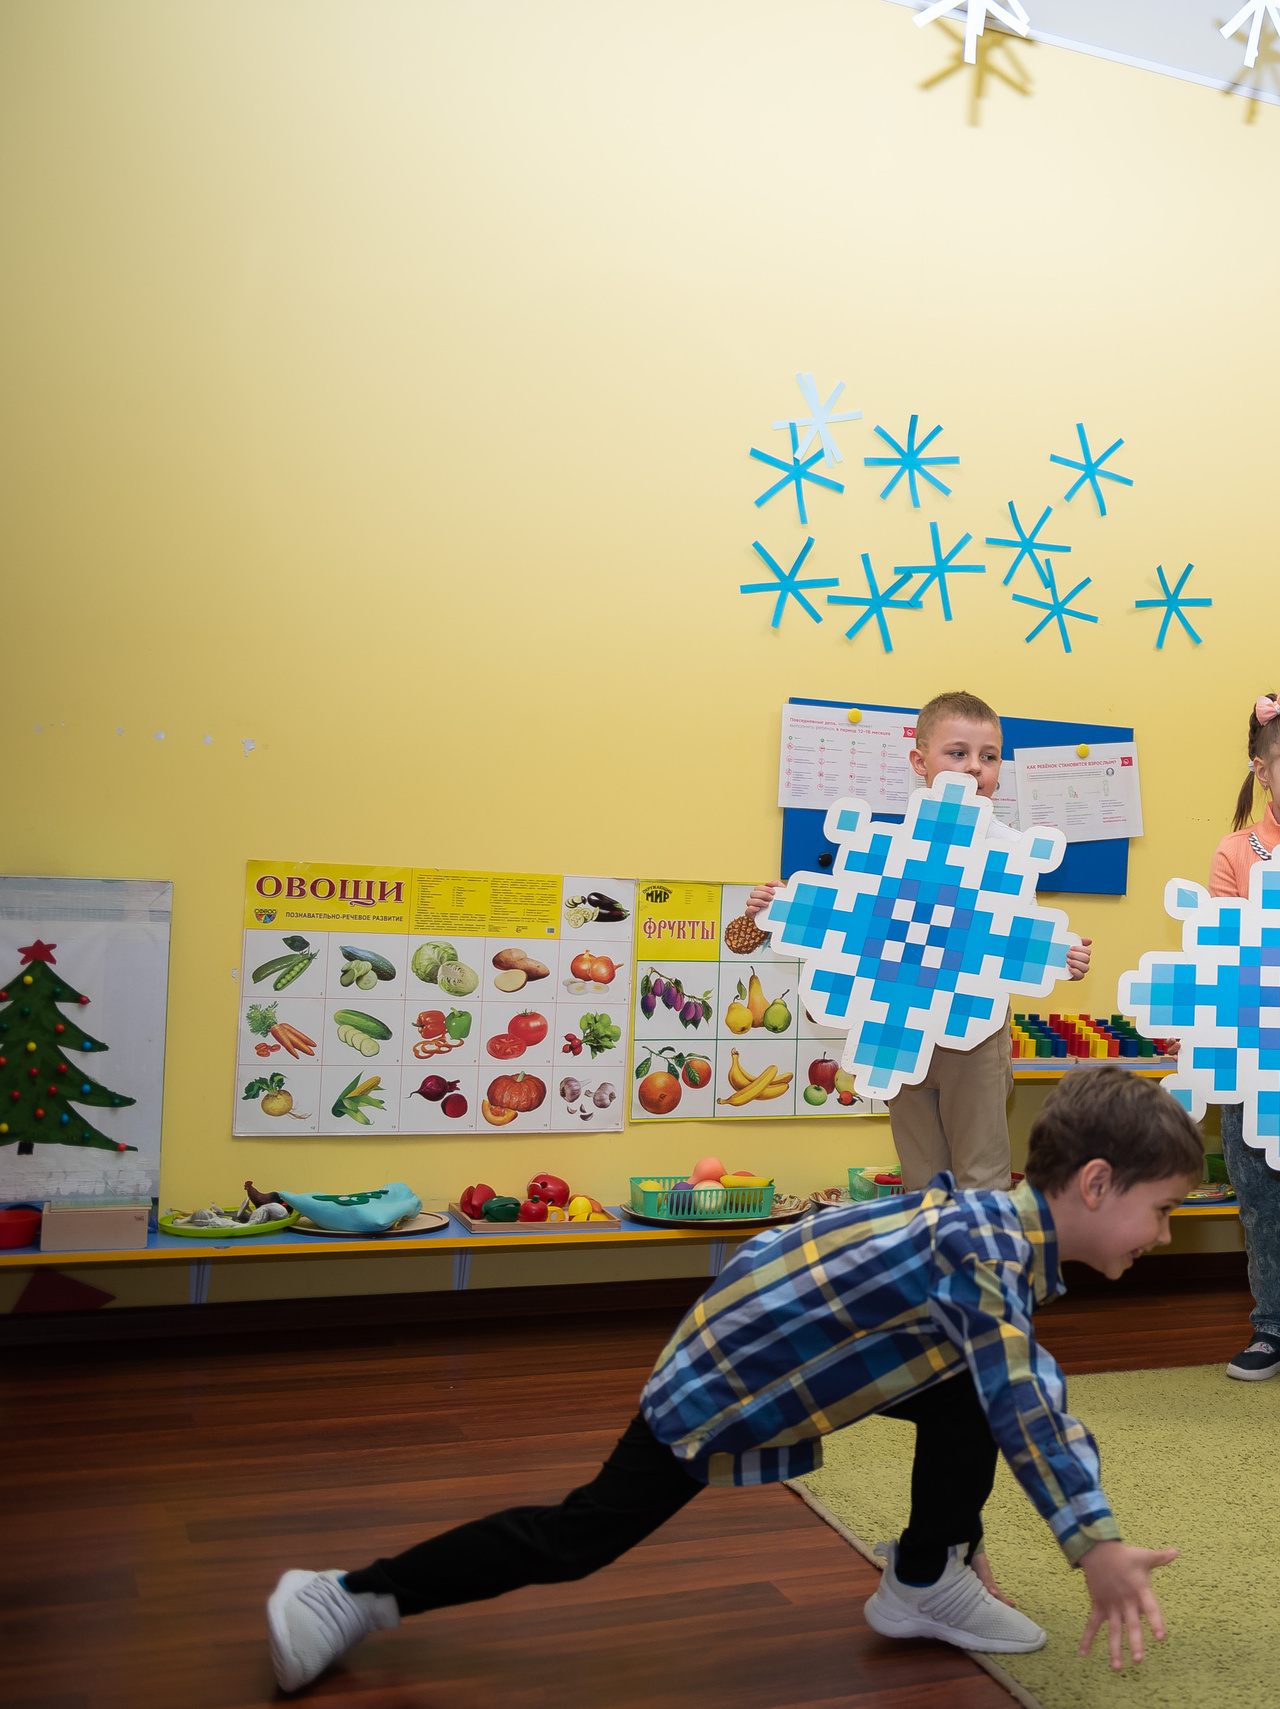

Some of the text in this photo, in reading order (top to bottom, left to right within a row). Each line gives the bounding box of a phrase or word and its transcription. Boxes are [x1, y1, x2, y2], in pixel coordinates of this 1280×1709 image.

[790, 717, 824, 725] Повседневные
[255, 875, 405, 907] ОВОЩИ
[642, 885, 673, 895] ОКРУЖАЮЩИЙ
[645, 890, 670, 903] МИР
[285, 911, 371, 921] ПОЗНАВАТЕЛЬНО-РЕЧЕВОЕ
[642, 917, 716, 940] ФРУКТЫ
